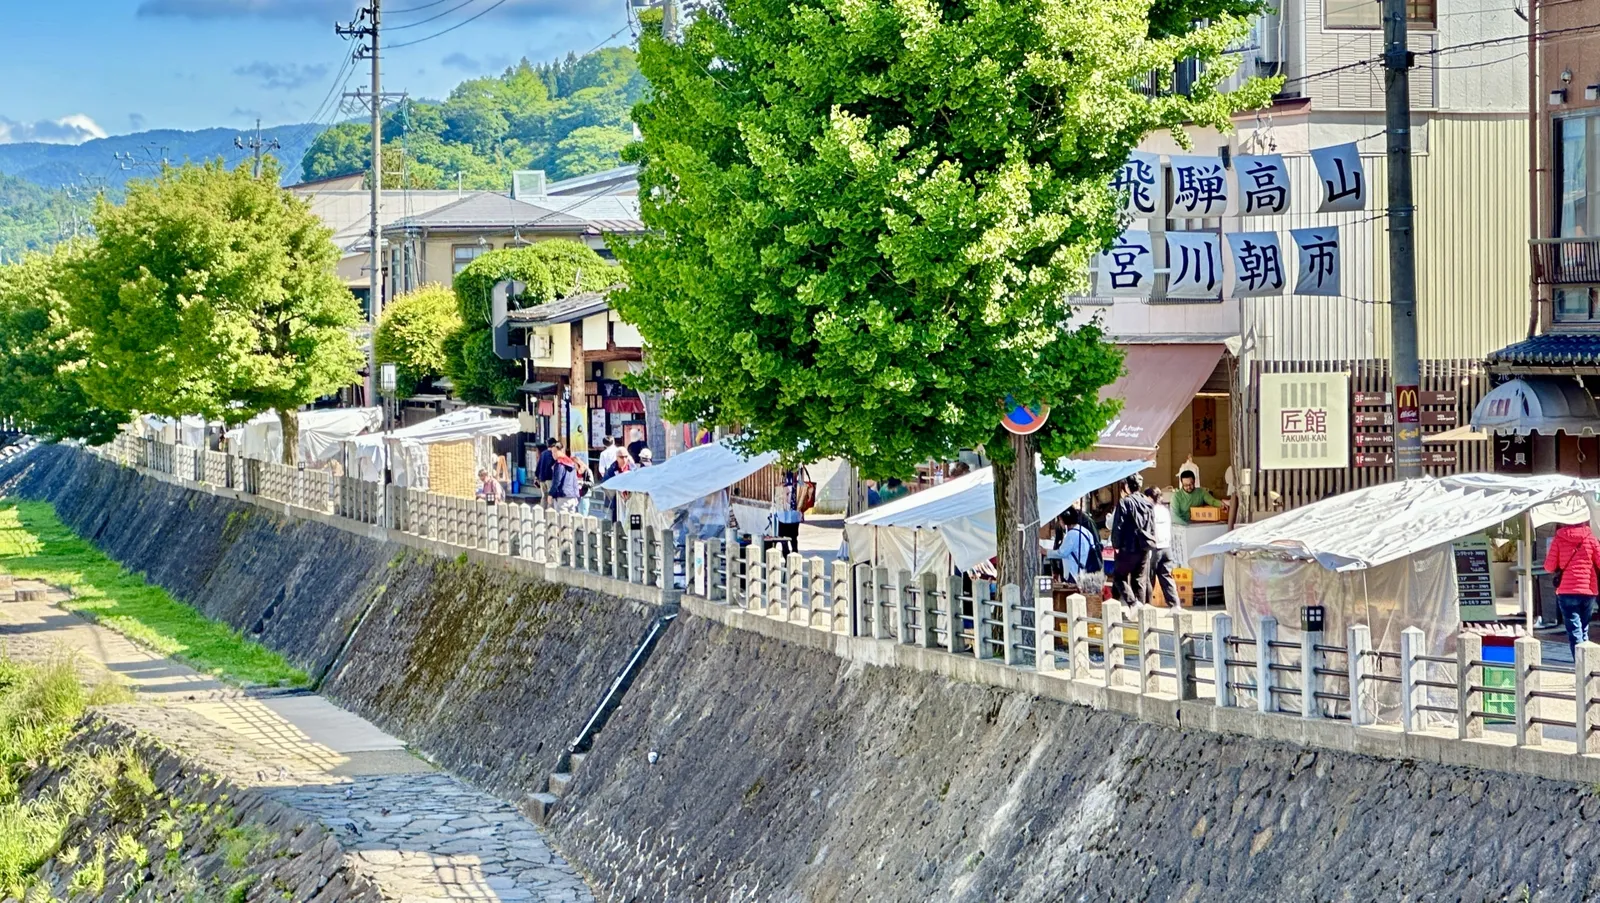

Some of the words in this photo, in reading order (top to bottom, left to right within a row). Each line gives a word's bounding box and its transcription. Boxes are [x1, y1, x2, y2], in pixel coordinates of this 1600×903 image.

[1102, 235, 1338, 291] 宮川朝市
[1281, 408, 1327, 434] 匠館
[1355, 415, 1364, 423] 2F
[1281, 434, 1327, 442] TAKUMI-KAN
[1355, 435, 1364, 443] 1F
[1355, 456, 1364, 464] 1F
